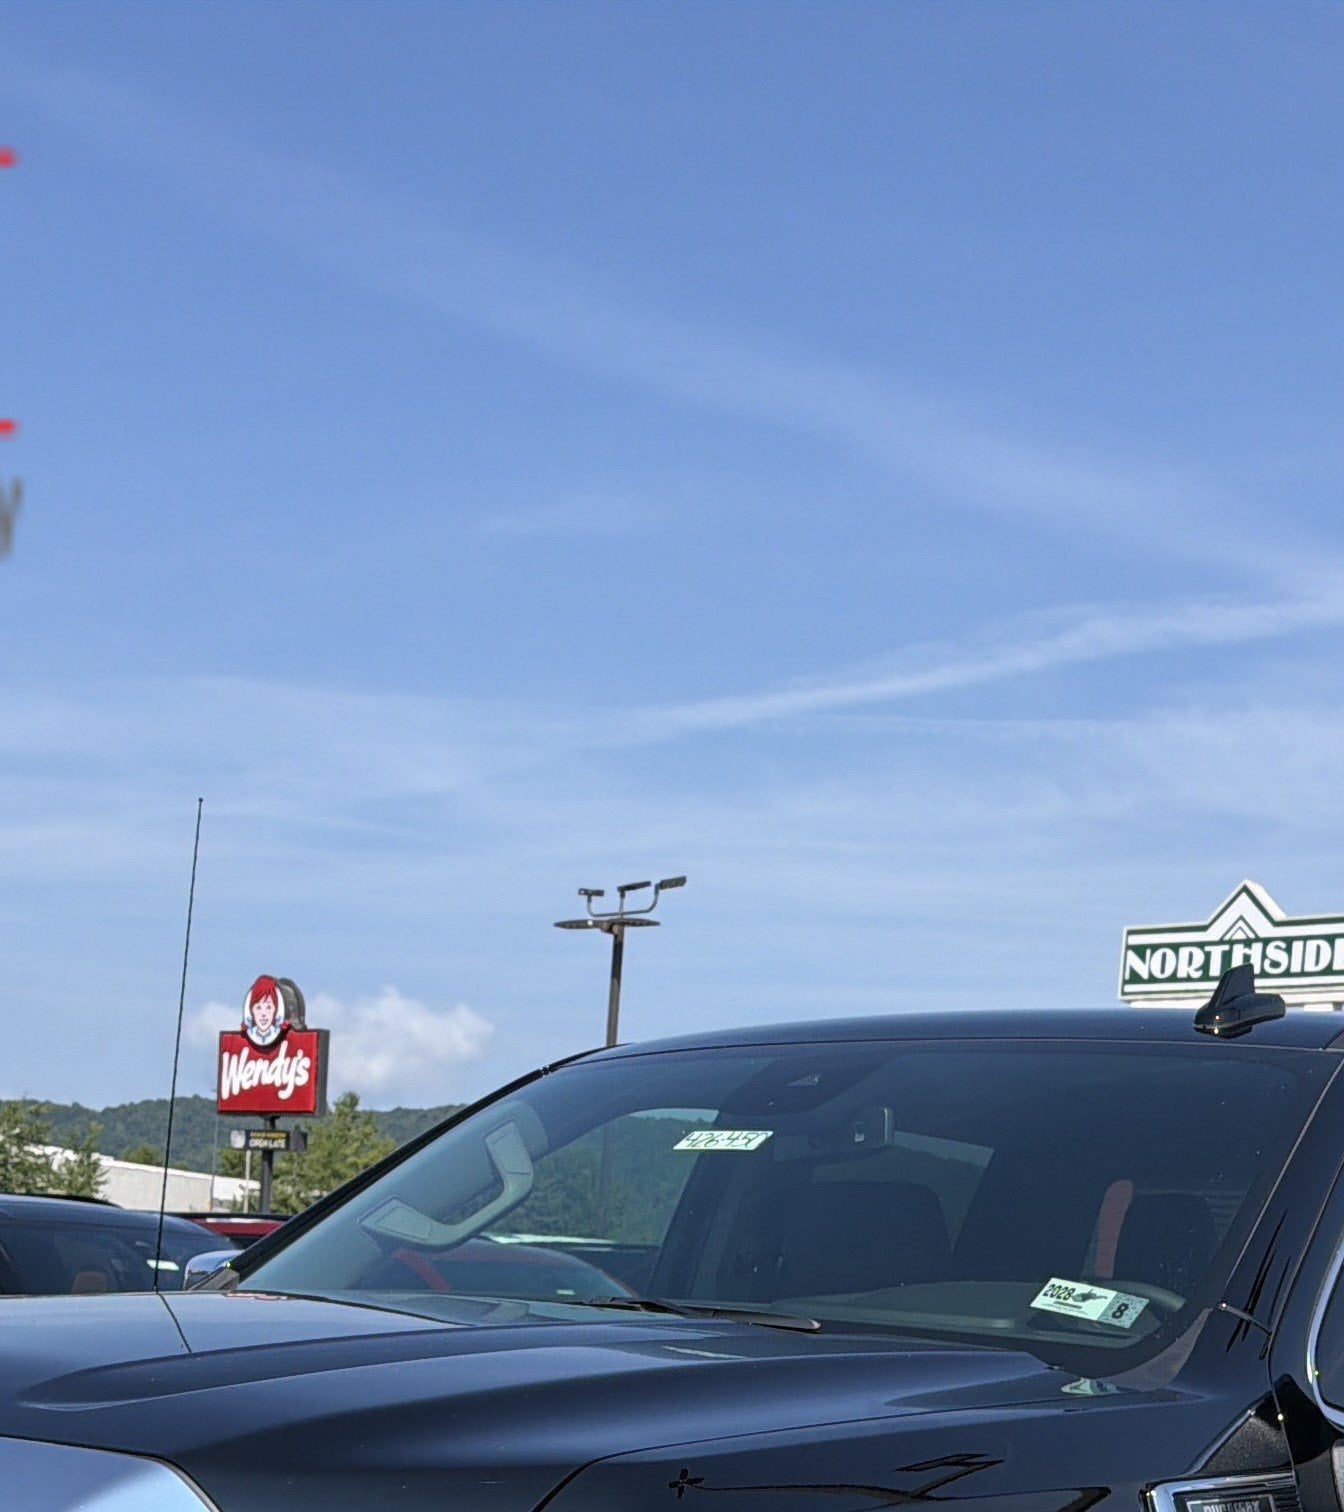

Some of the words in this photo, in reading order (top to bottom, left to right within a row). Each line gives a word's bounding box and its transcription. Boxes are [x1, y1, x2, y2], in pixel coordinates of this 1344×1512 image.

[221, 1040, 311, 1100] Wendy's
[1041, 1283, 1077, 1301] 2028
[1111, 1302, 1130, 1319] 8
